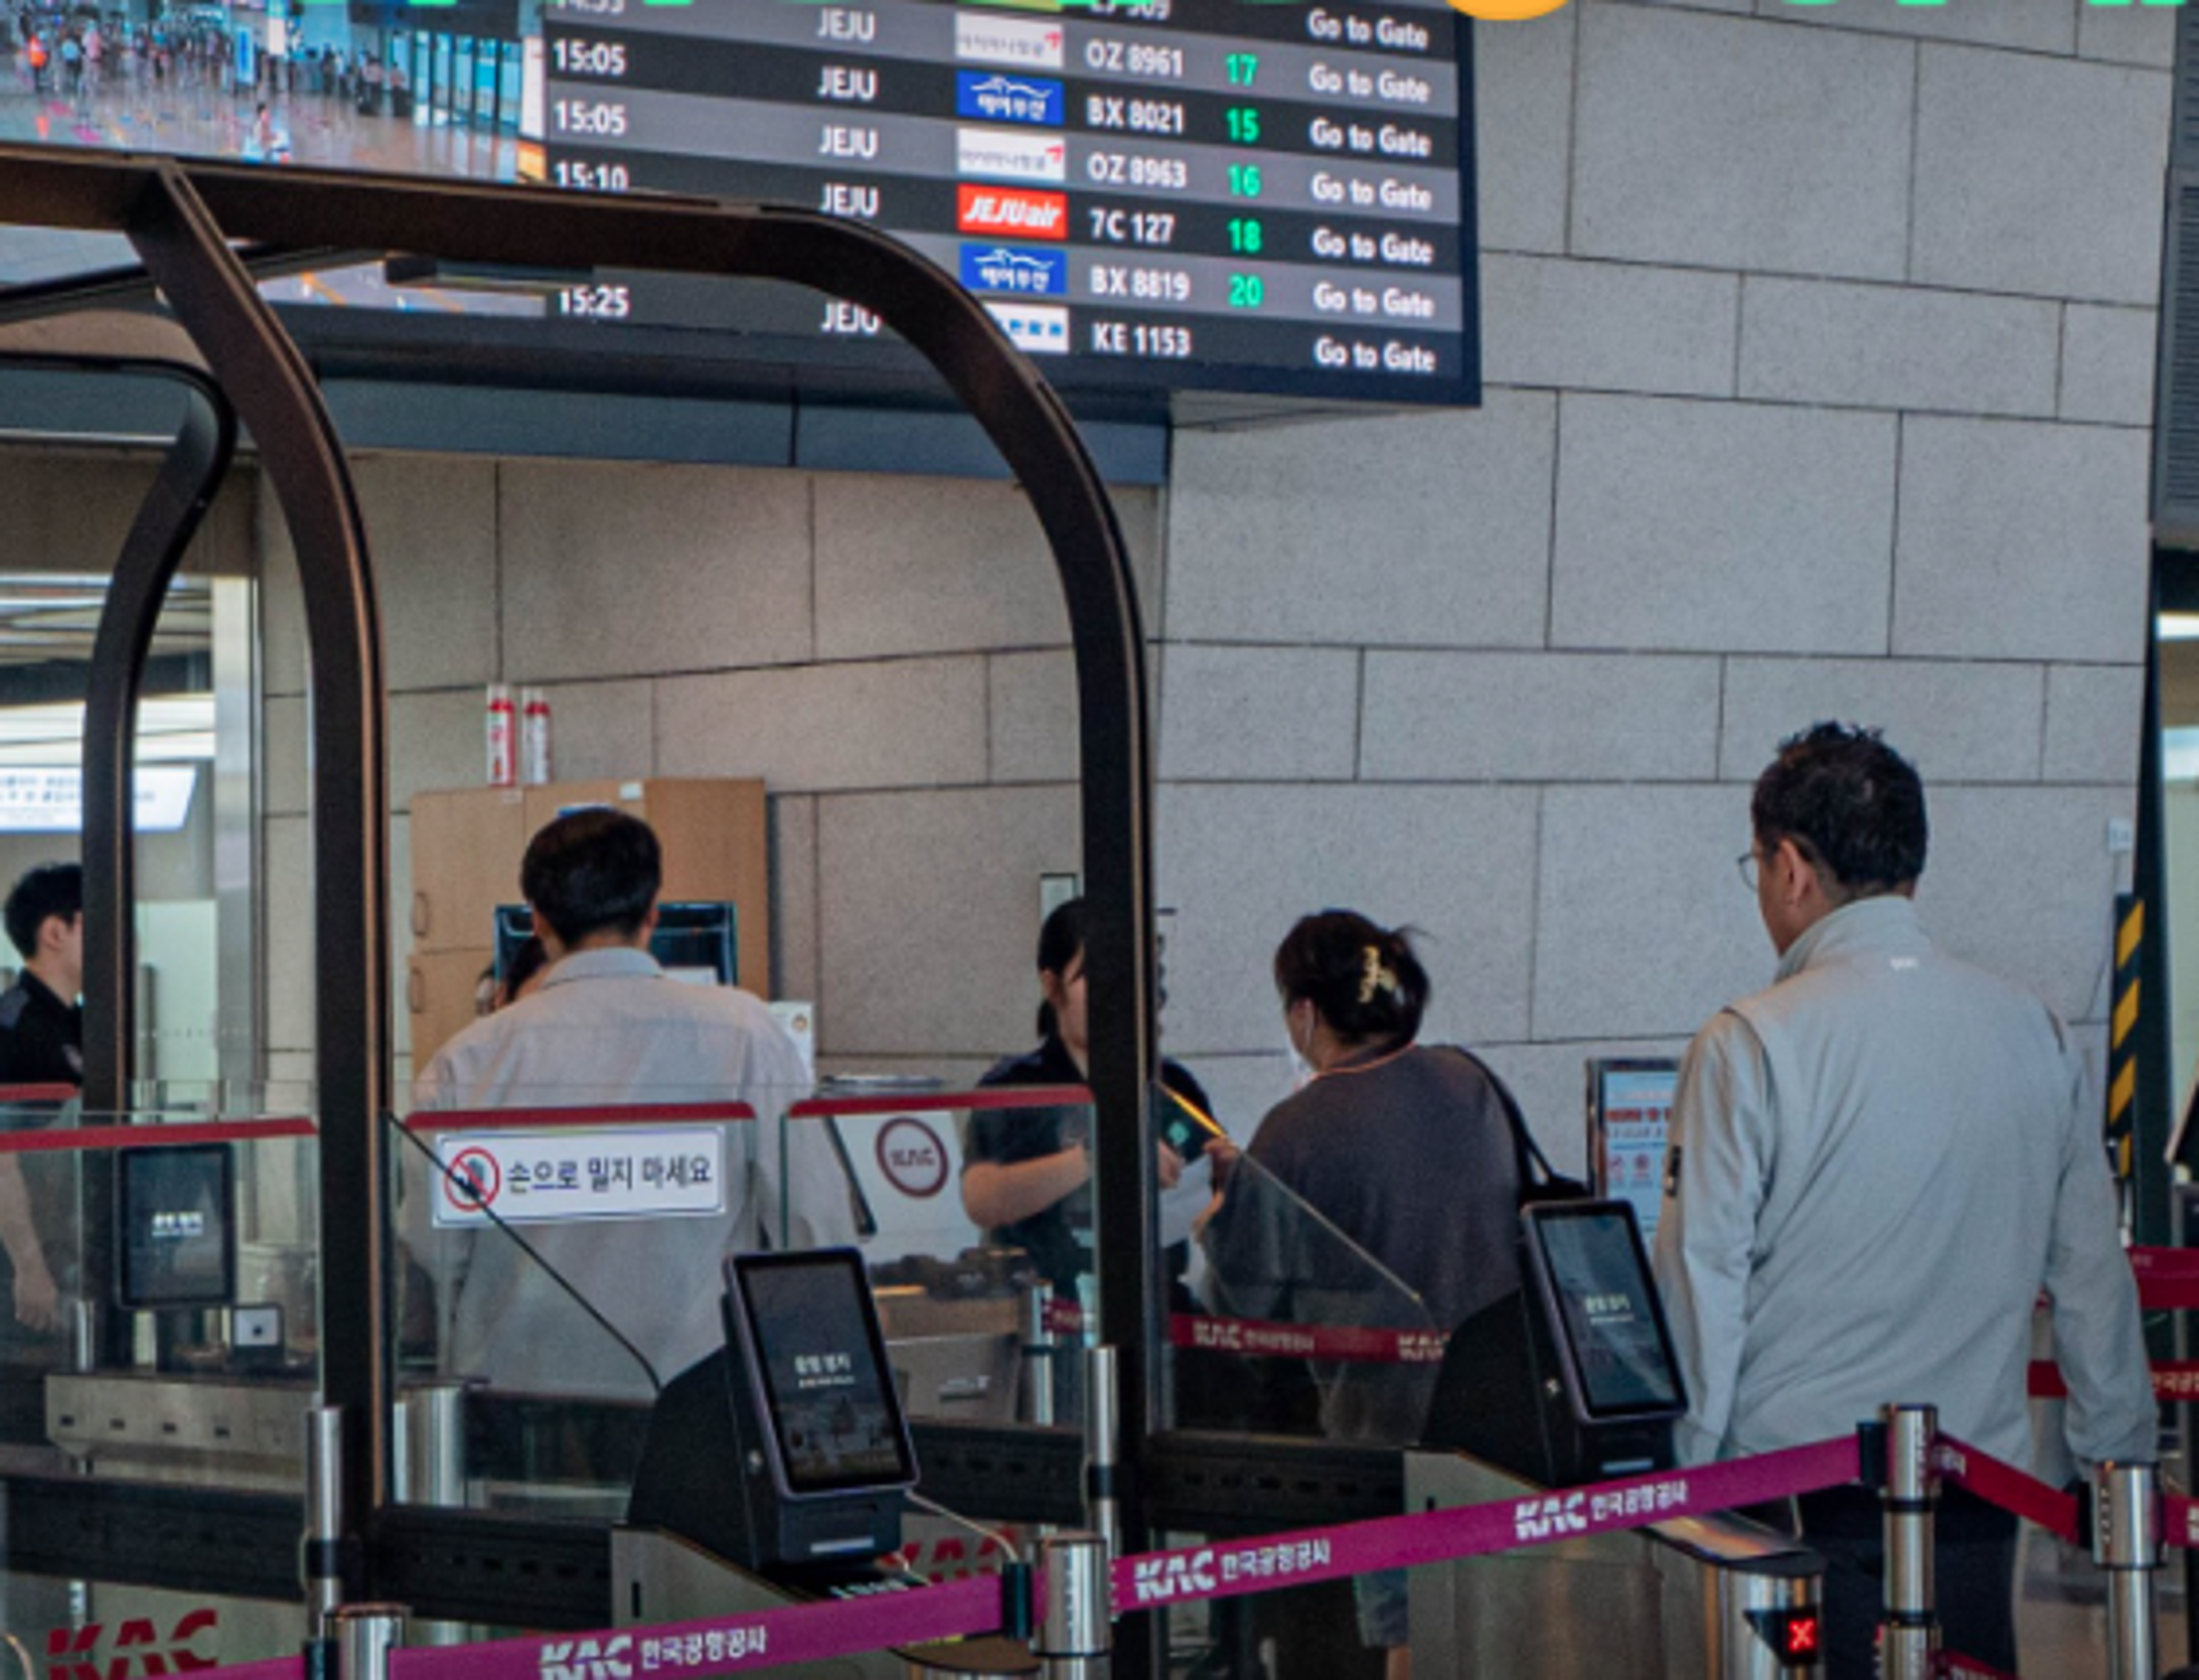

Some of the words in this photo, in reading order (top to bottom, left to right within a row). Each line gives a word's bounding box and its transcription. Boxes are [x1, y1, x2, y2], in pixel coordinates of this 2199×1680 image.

[817, 7, 876, 40] JEJU
[1307, 7, 1341, 39] Go
[1347, 15, 1372, 42] to
[1376, 17, 1428, 50] Gate
[553, 38, 627, 76] 15:05
[1086, 39, 1123, 71] OZ
[1226, 53, 1258, 86] 17
[817, 66, 879, 101] JEJU
[1308, 63, 1342, 93] Go
[1347, 70, 1373, 96] to
[1377, 70, 1430, 104] Gate
[553, 100, 628, 136] 15:05
[1087, 95, 1124, 126] BX
[1129, 100, 1184, 134] 8021
[1227, 108, 1260, 142] 15
[818, 125, 879, 159] JEJU
[1309, 117, 1343, 147] Go
[1348, 124, 1373, 151] to
[1378, 124, 1432, 158] Gate
[554, 160, 629, 191] 15:10
[1088, 153, 1127, 182] OZ
[1228, 165, 1262, 197] 16
[819, 183, 880, 218] JEJU
[1312, 171, 1345, 202] Go
[1350, 179, 1374, 205] to
[1380, 179, 1432, 211] Gate
[1090, 208, 1126, 239] 7C
[1131, 213, 1175, 244] 127
[1229, 219, 1262, 253] 18
[1312, 227, 1346, 257] Go
[1350, 234, 1376, 260] to
[1381, 233, 1434, 266] Gate
[558, 283, 629, 318] 15:25
[1090, 266, 1127, 295] BX
[1132, 270, 1190, 301] 8819
[1229, 273, 1264, 308] 20
[1313, 281, 1347, 311] Go
[1351, 288, 1377, 313] to
[1382, 288, 1436, 318] Gate
[821, 300, 881, 335] JEJU
[1093, 322, 1128, 353] KE
[1133, 325, 1192, 358] 1153
[1314, 335, 1349, 366] Go
[1352, 342, 1379, 368] to
[1383, 341, 1437, 373] Gate
[507, 1161, 581, 1195] 손으로
[587, 1156, 633, 1193] 밀지
[642, 1154, 714, 1191] 마세요
[1515, 1490, 1588, 1541] KAC
[1134, 1549, 1217, 1602] KAC
[1221, 1538, 1330, 1581] 한국공항공사
[47, 1609, 219, 1680] KAC
[541, 1633, 633, 1680] KAC
[642, 1624, 766, 1670] 한국공항공사
